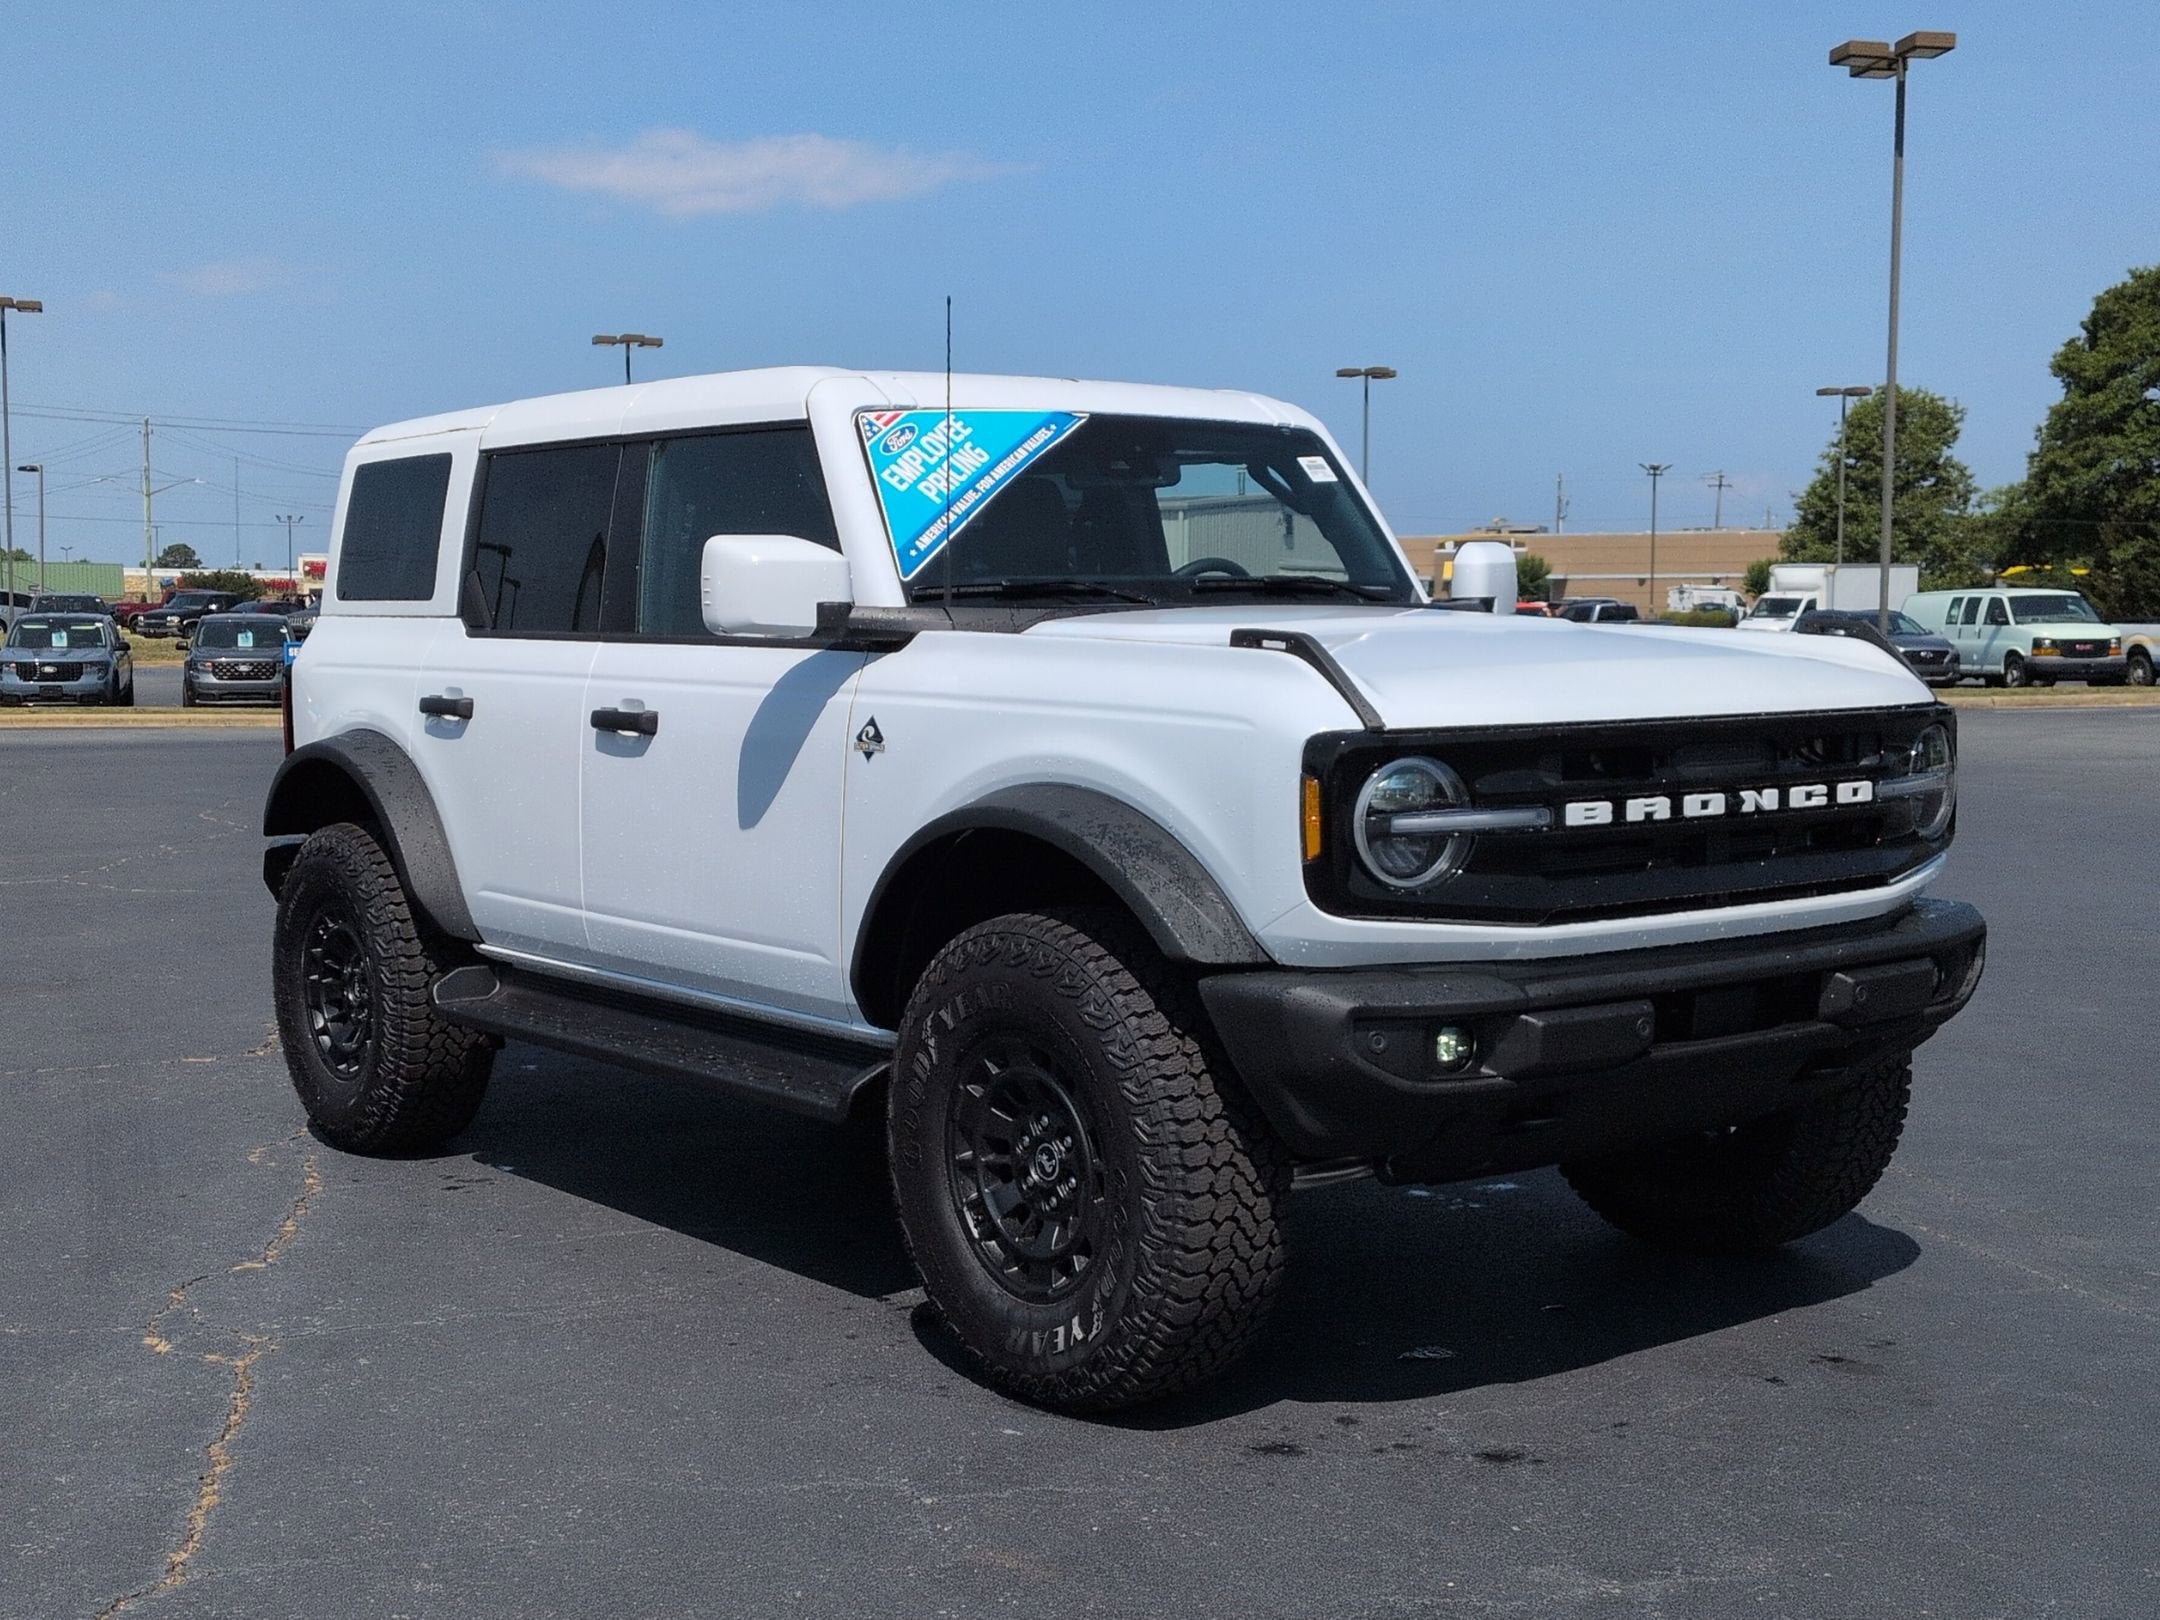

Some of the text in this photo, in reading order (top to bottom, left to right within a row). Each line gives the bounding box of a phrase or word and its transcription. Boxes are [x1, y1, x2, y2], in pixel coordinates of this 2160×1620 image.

[880, 414, 973, 492] EMPLOYEE
[887, 428, 913, 452] Ford
[915, 508, 958, 551] AMERICAN
[975, 475, 996, 493] FOR
[990, 447, 1029, 480] AMERICAN
[917, 441, 990, 504] PRICING
[1565, 780, 1873, 826] BRONCO
